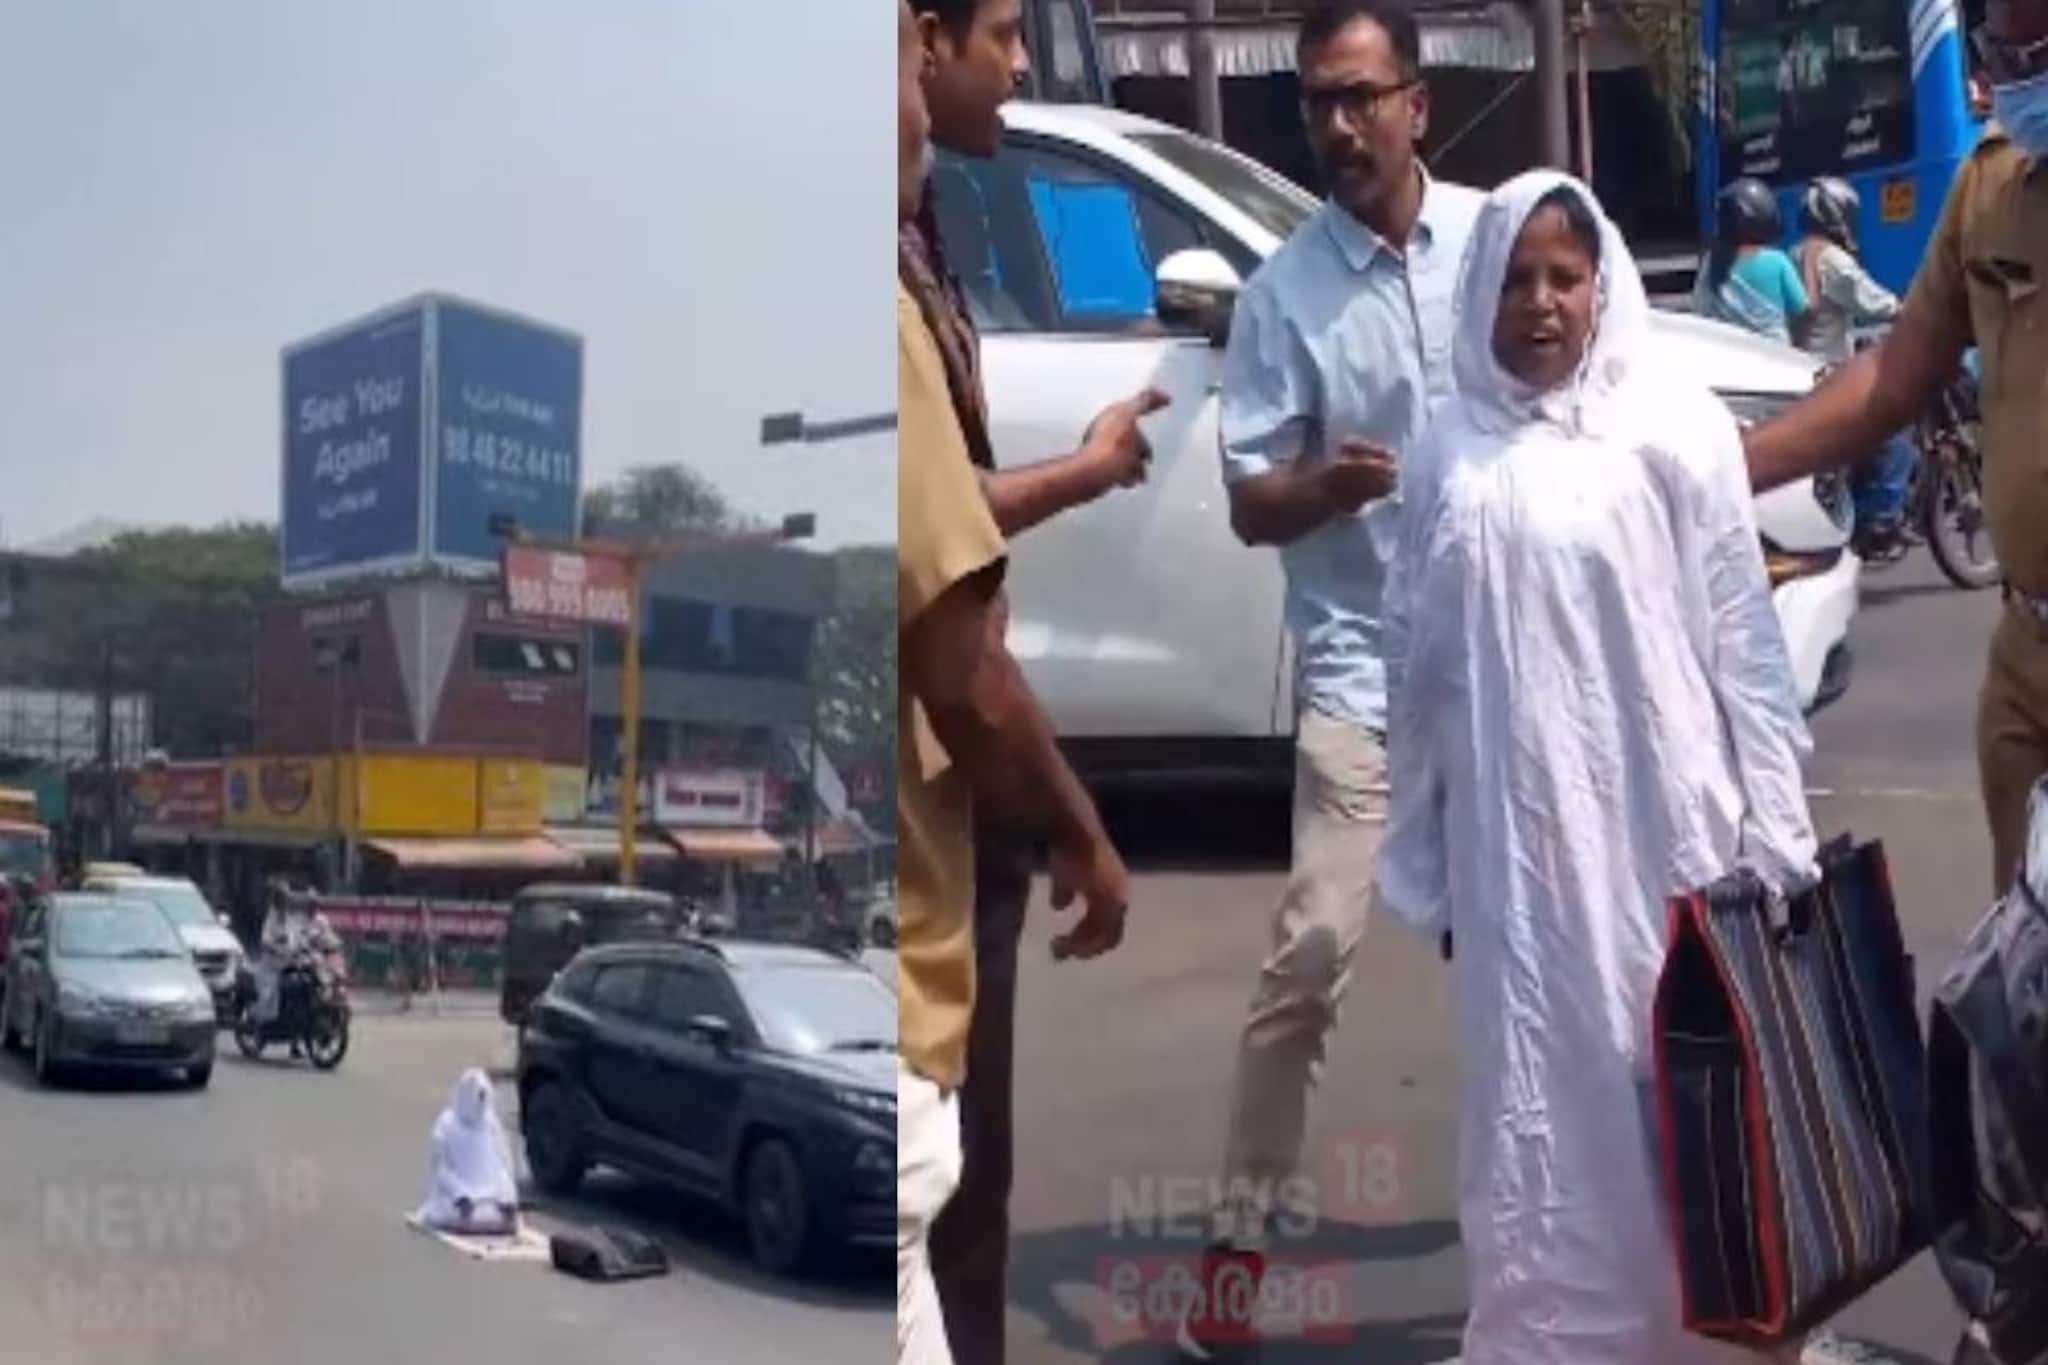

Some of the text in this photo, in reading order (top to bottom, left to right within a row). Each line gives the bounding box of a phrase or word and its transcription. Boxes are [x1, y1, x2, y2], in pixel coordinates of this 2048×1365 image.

[299, 375, 405, 434] See You
[314, 427, 391, 485] Again
